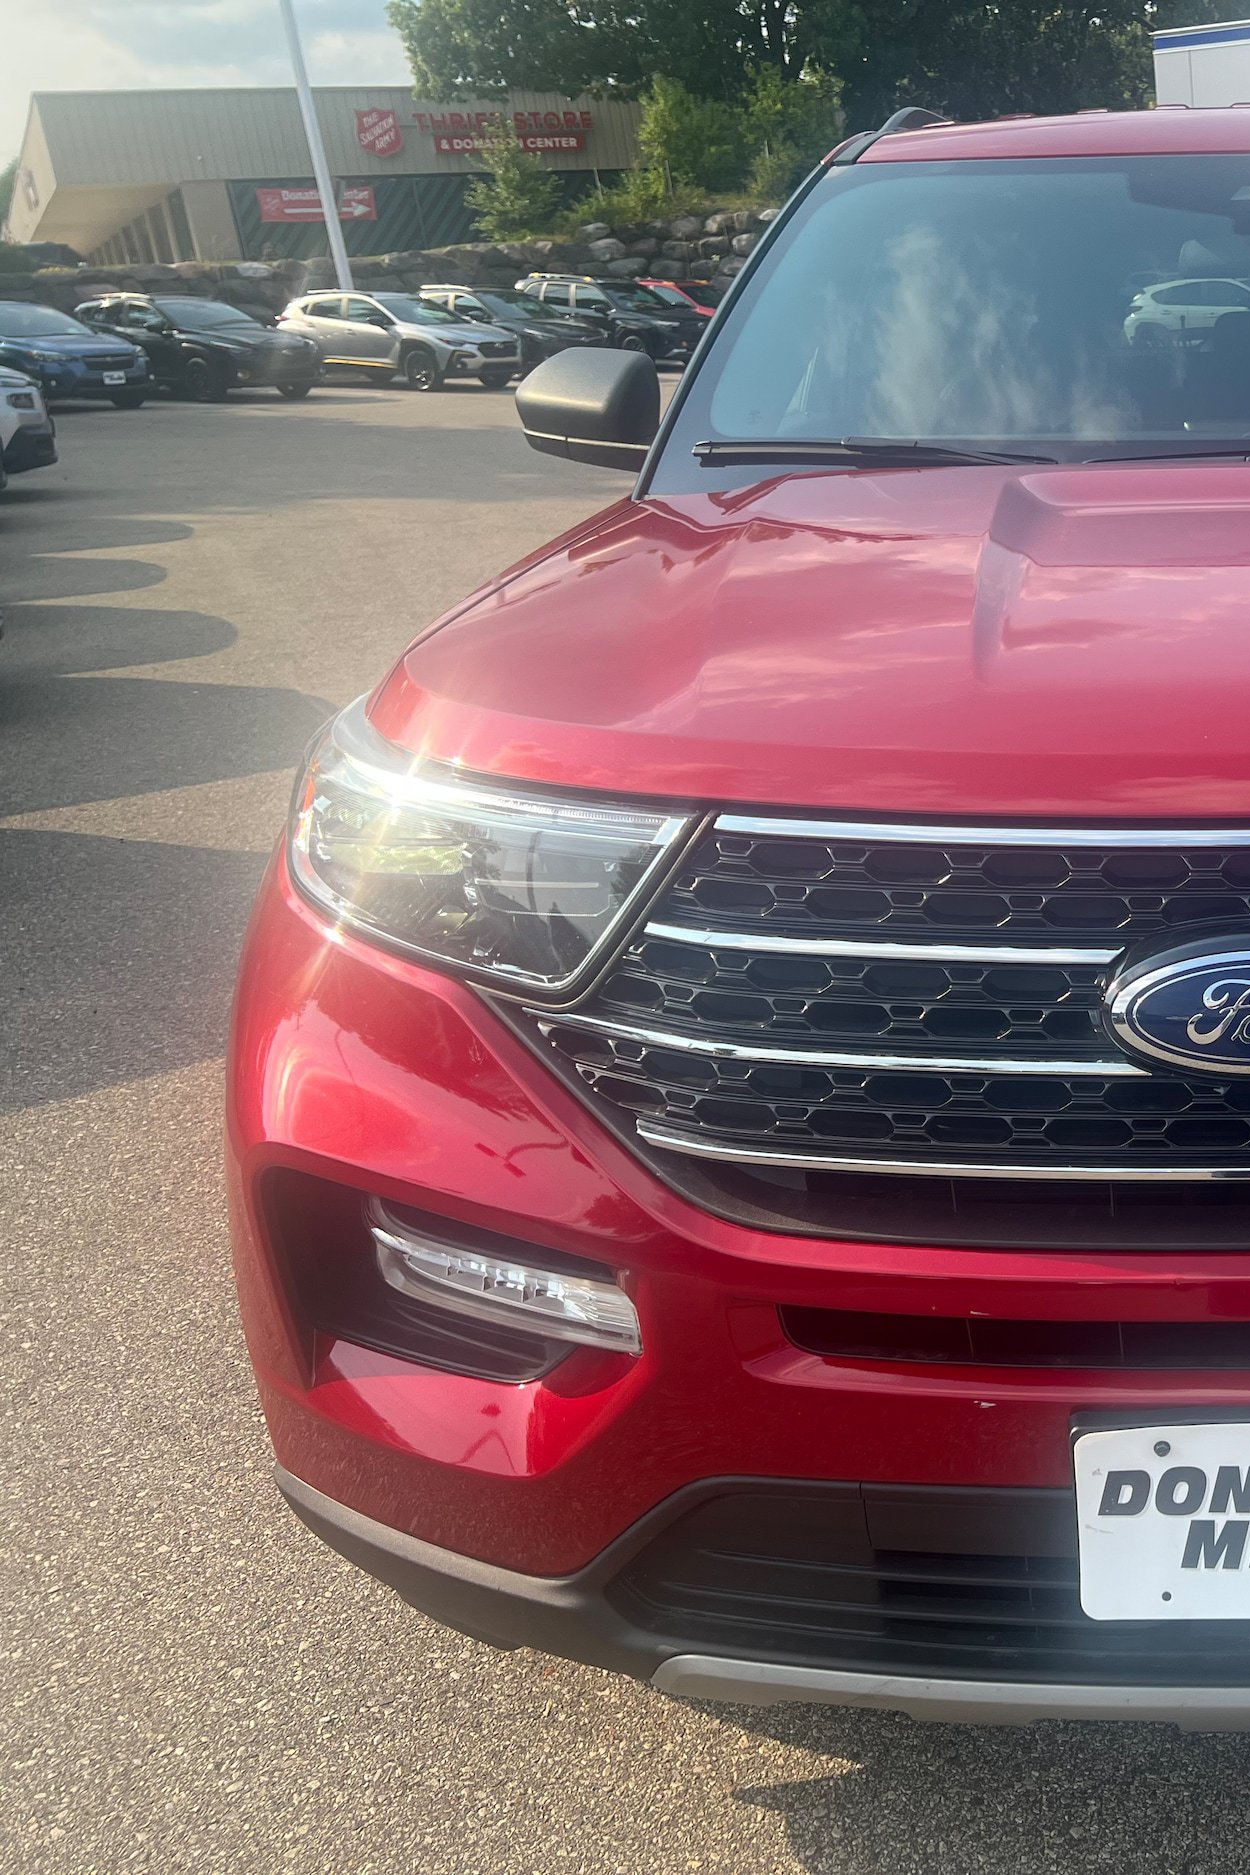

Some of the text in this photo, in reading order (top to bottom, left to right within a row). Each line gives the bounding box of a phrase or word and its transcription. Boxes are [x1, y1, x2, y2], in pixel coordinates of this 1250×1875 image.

[360, 113, 394, 145] SALVATION
[363, 112, 379, 128] THE
[412, 111, 593, 131] THRIFT STORE
[375, 128, 396, 151] ARMY
[440, 138, 449, 150] &
[526, 137, 577, 149] CENTER
